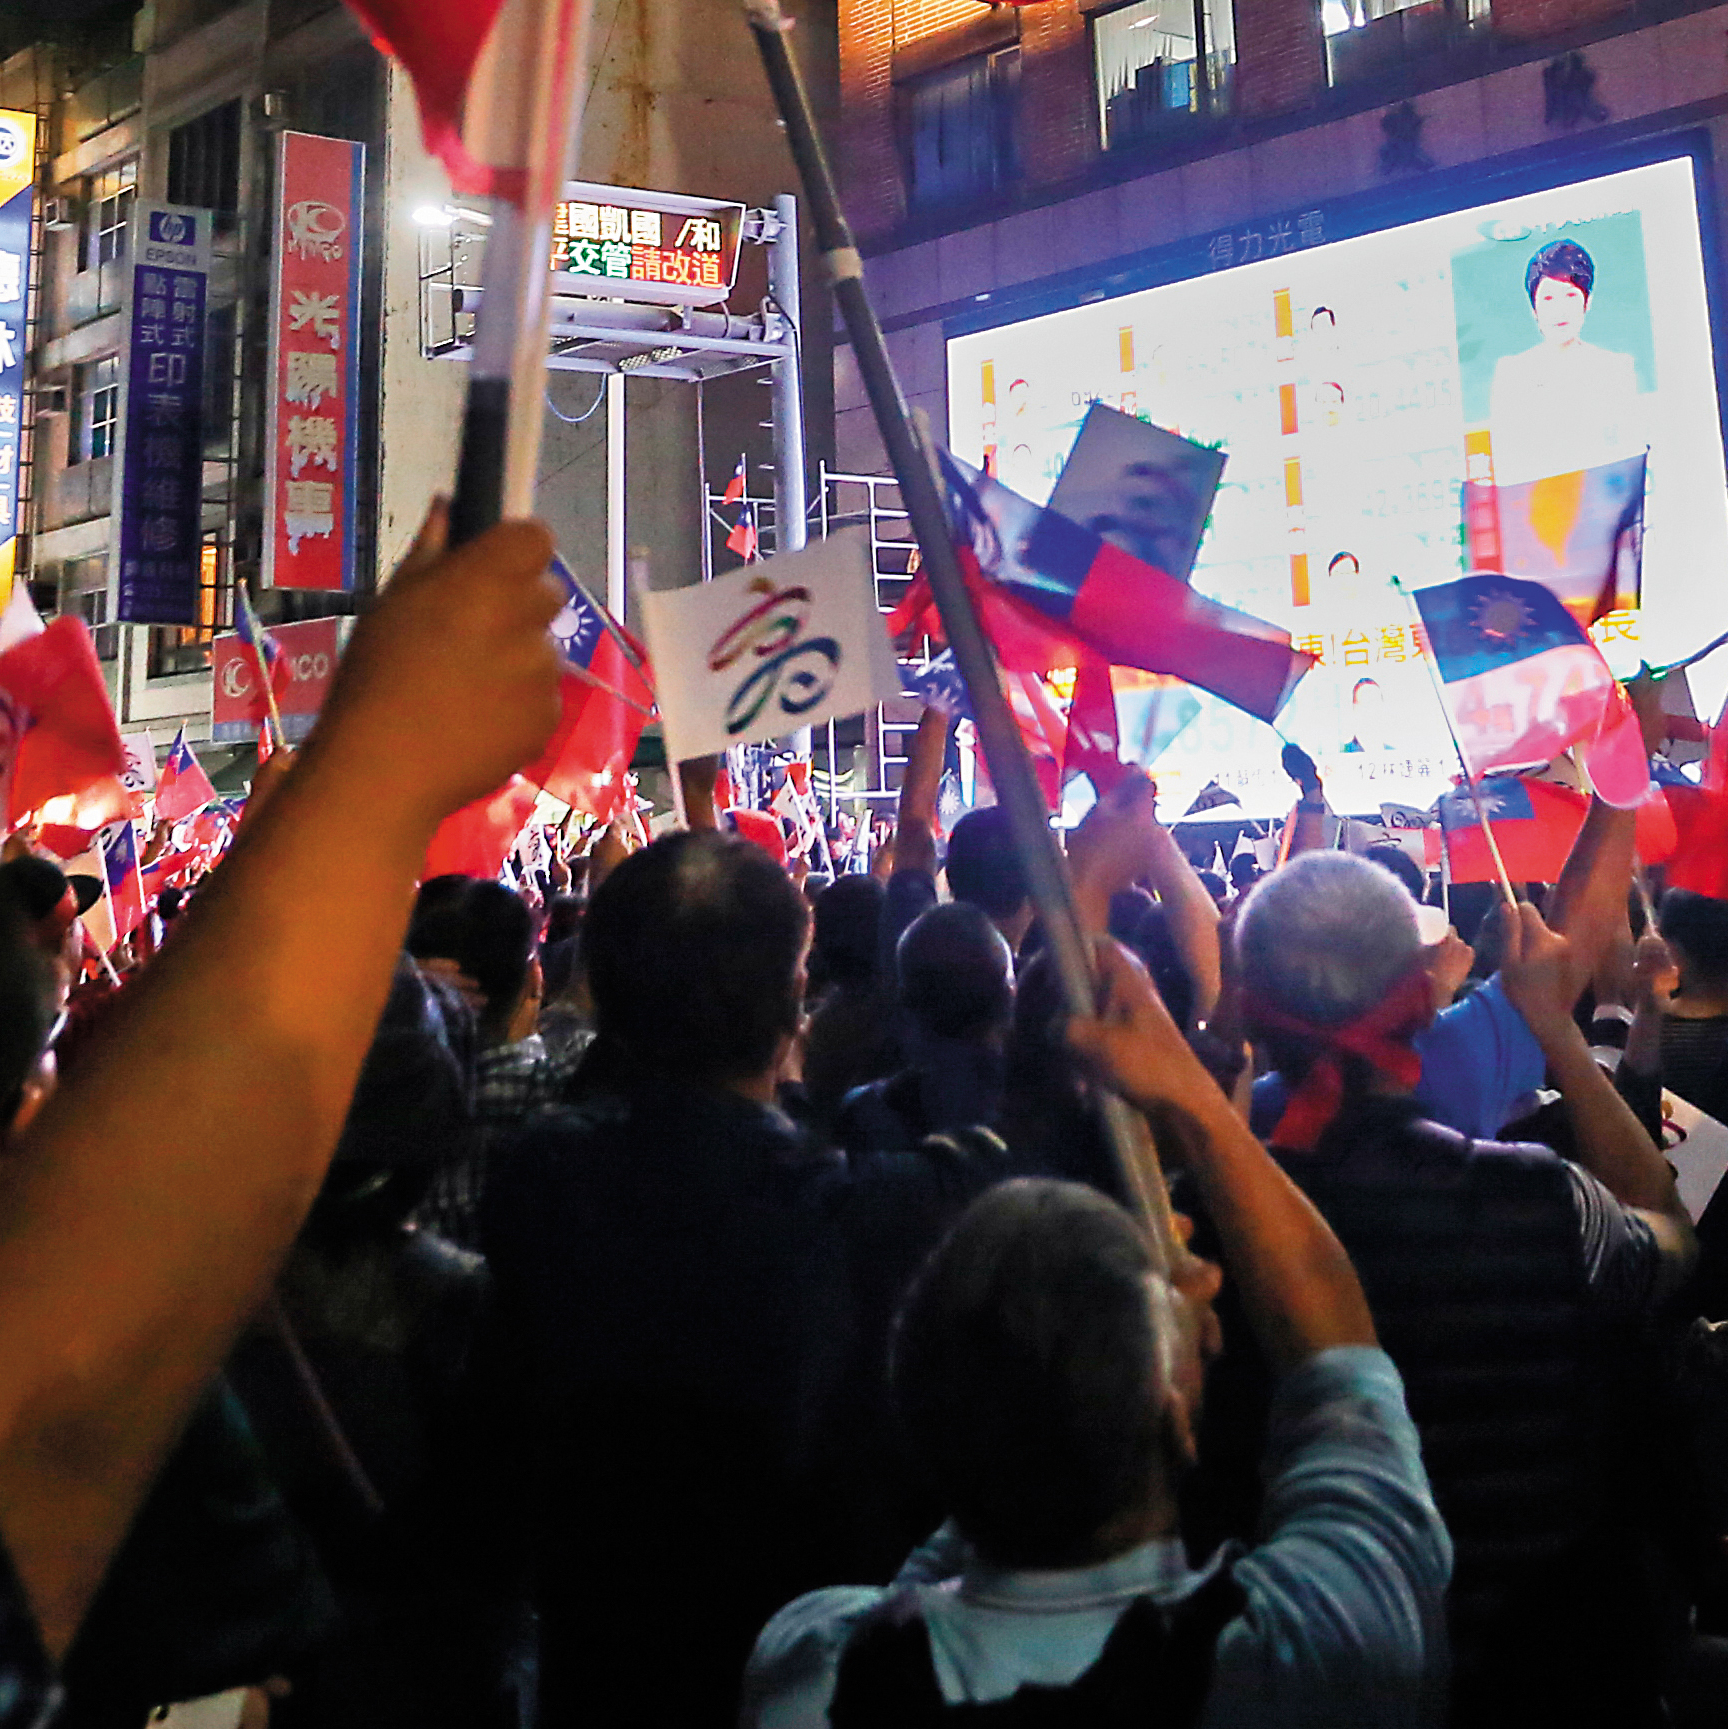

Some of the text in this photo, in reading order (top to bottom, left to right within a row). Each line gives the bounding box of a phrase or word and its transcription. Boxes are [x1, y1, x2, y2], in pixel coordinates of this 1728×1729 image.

[146, 247, 196, 265] EPSON
[1208, 209, 1326, 270] 得力光電
[284, 290, 341, 557] 光陽機車
